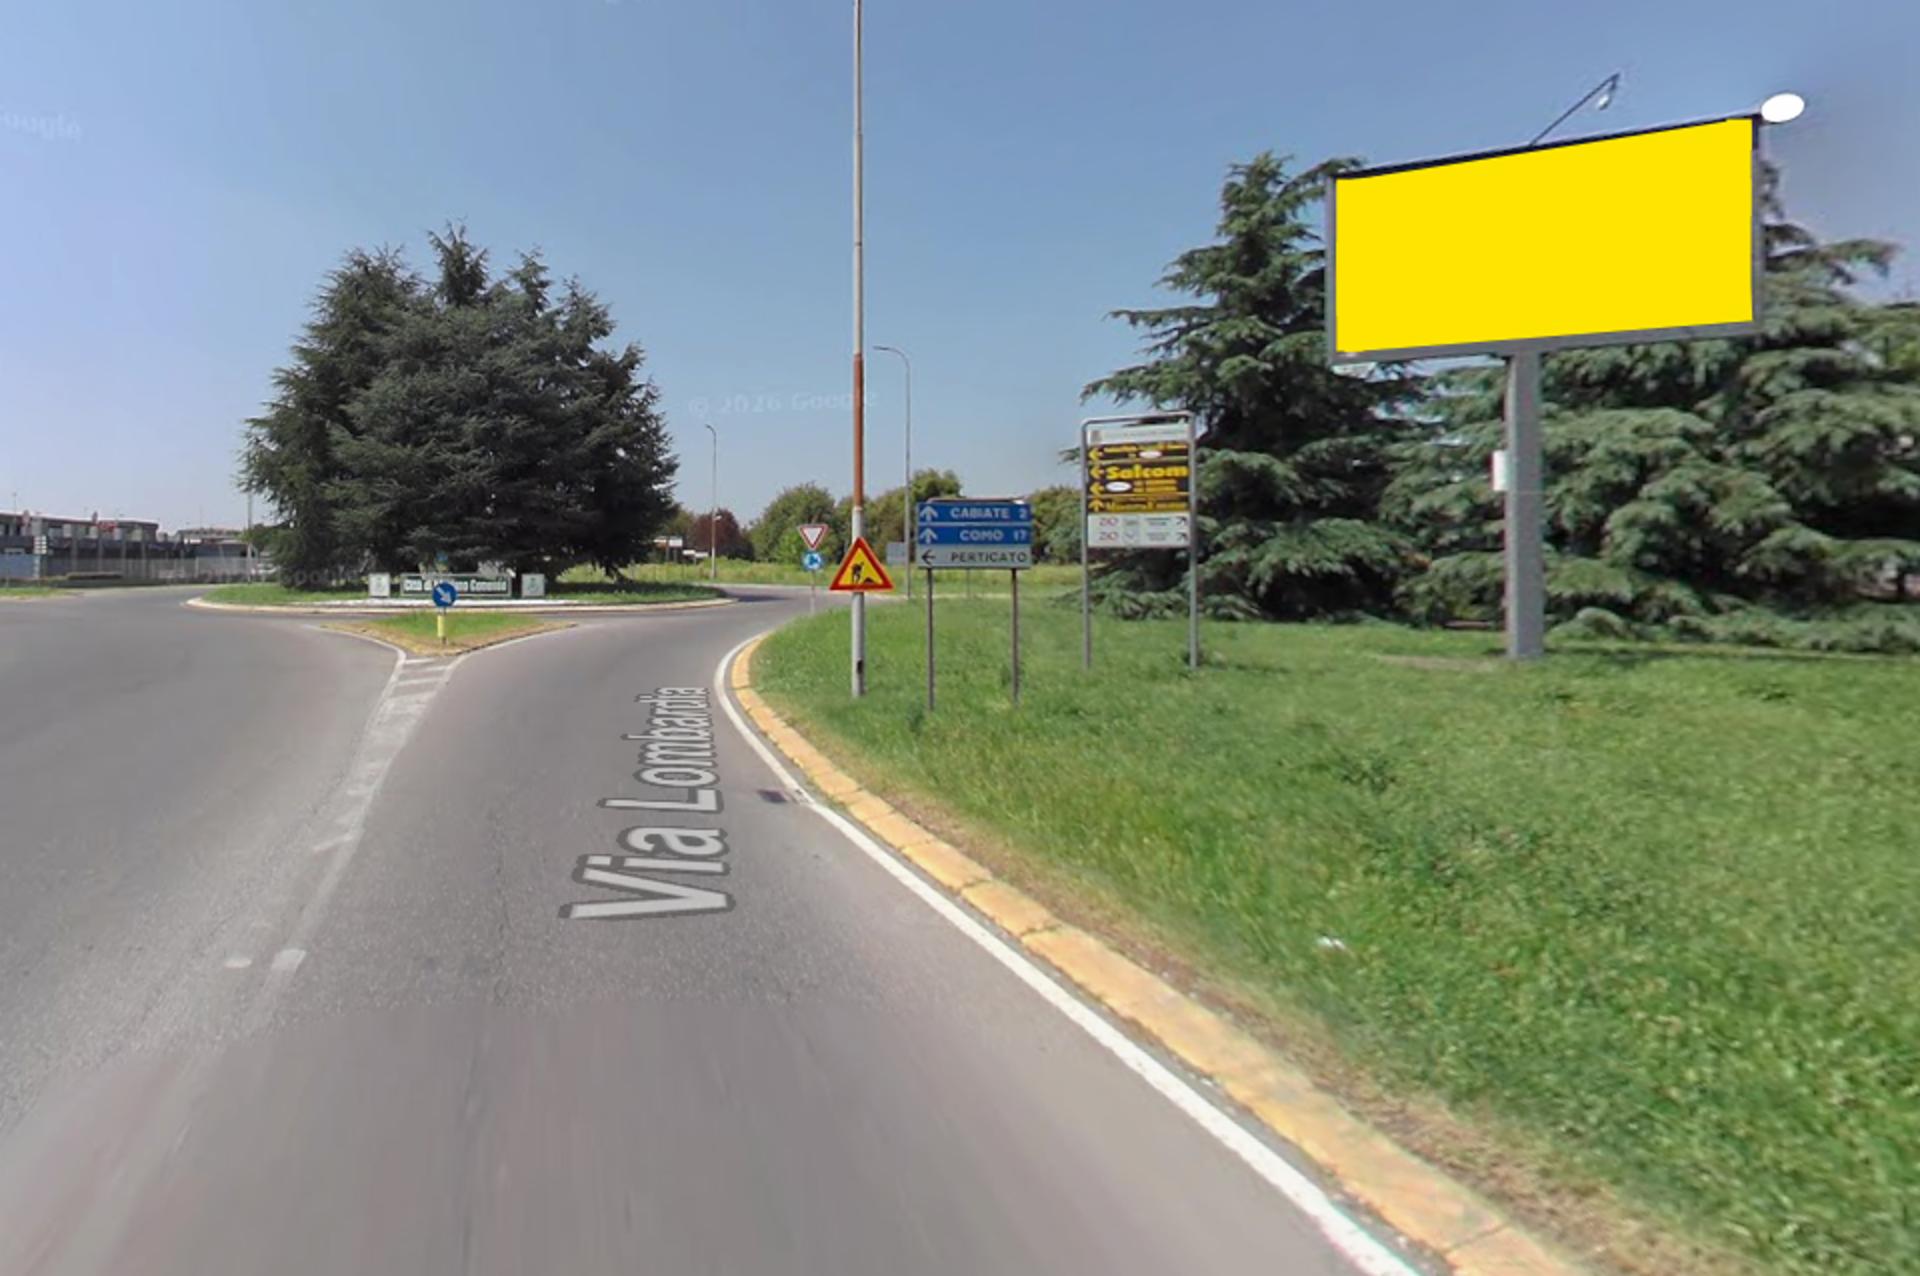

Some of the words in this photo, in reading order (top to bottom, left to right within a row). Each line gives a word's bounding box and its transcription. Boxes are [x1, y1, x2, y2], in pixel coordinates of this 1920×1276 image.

[950, 507, 1010, 519] CABIATE
[1018, 508, 1028, 519] 2
[959, 529, 1005, 541] COMO
[1013, 530, 1028, 541] 17
[950, 551, 1027, 563] PERTICATO
